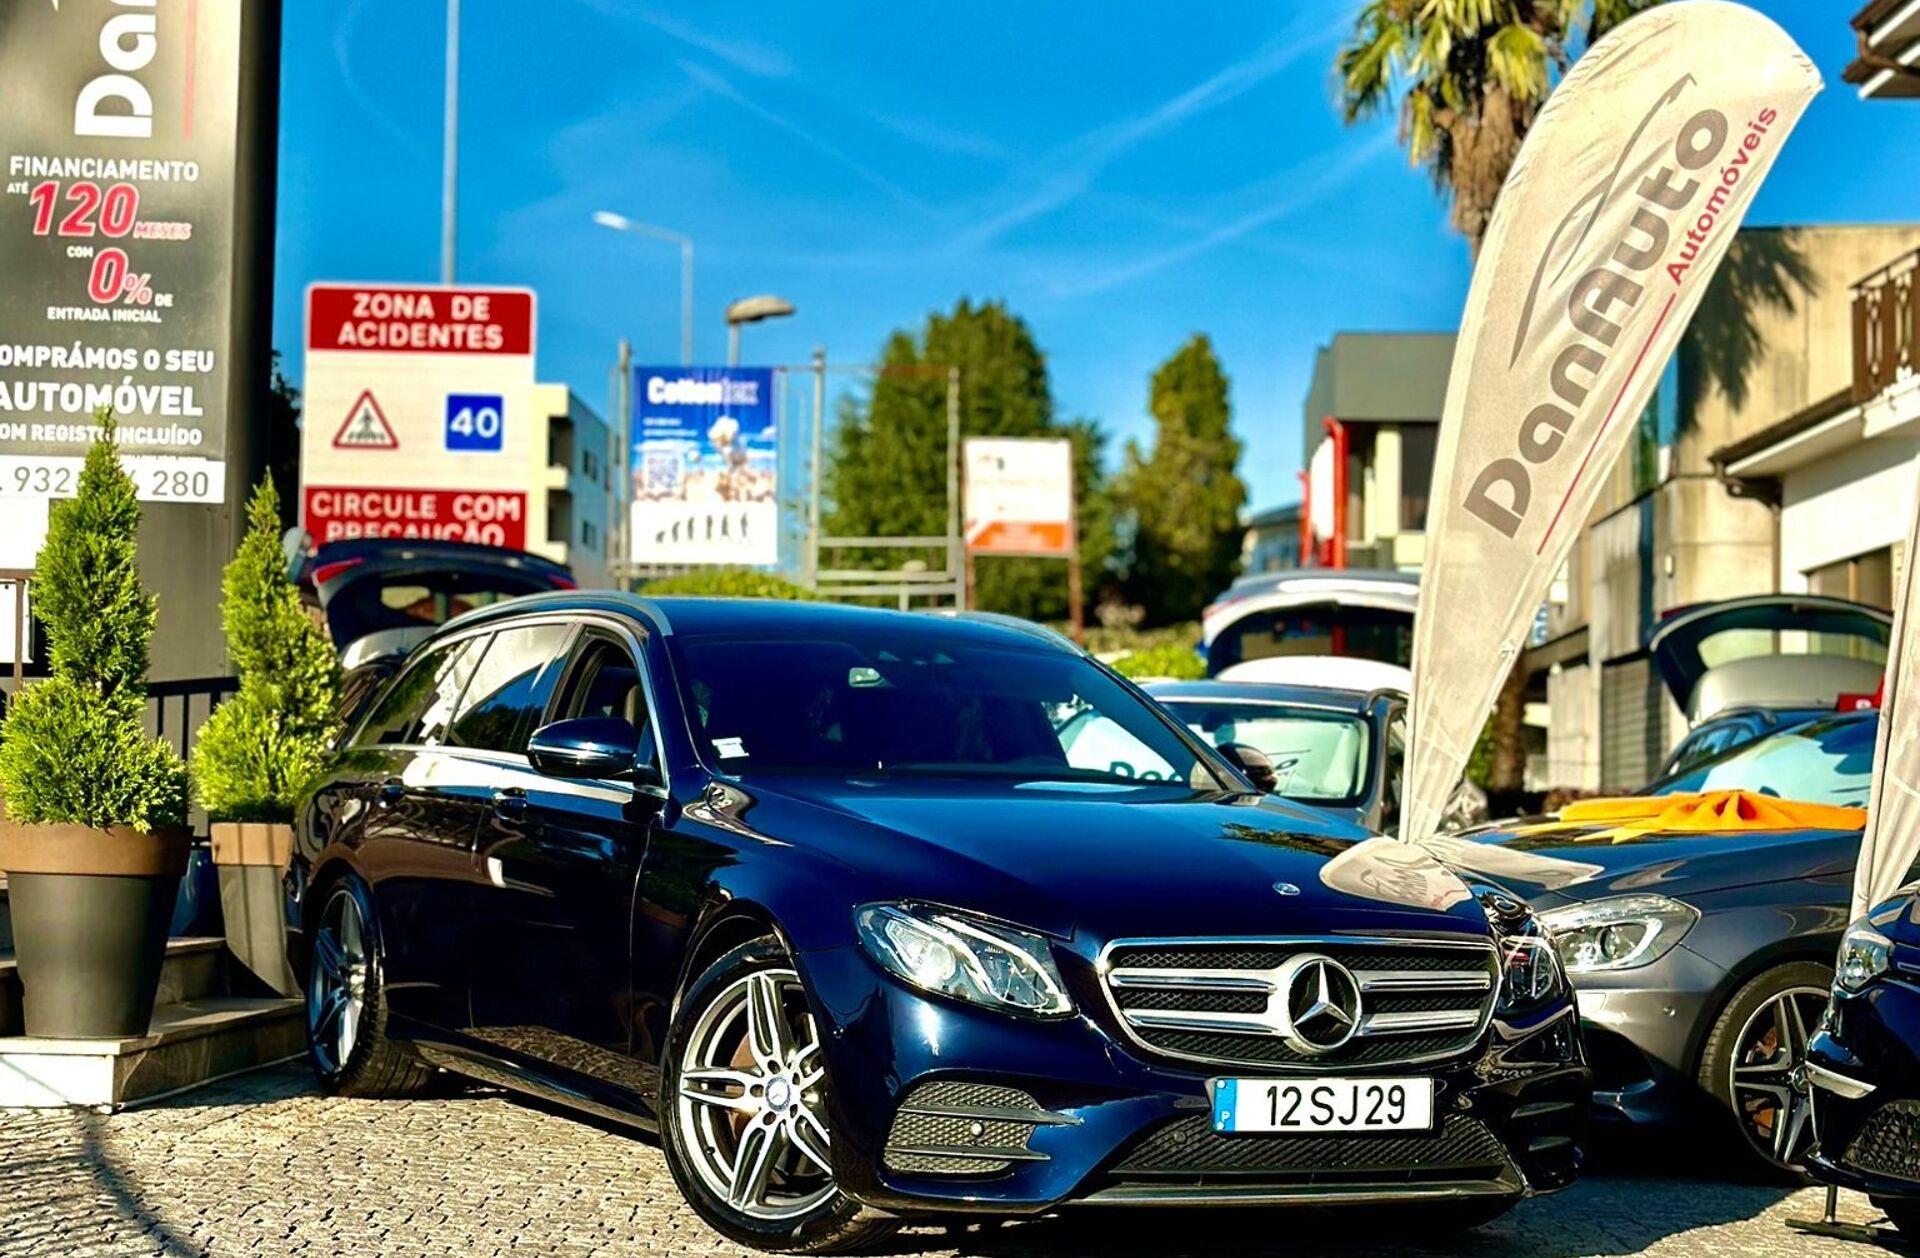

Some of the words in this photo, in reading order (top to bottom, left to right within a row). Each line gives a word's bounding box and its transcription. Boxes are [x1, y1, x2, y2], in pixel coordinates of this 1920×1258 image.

[74, 0, 157, 138] Da
[10, 156, 199, 181] FINANCIAMENTO
[7, 182, 29, 194] ATÉ
[29, 181, 139, 238] 120
[133, 221, 192, 240] MESES
[1667, 106, 1778, 286] Automóveis
[66, 246, 93, 258] COM
[88, 247, 152, 305] 0%
[155, 294, 174, 307] DE
[47, 307, 110, 322] ENTRADA
[113, 309, 162, 323] INICIAL
[352, 293, 435, 319] ZONA
[451, 295, 491, 321] DE
[337, 321, 504, 350] ACIDENTES
[1463, 108, 1730, 540] DanAuto
[143, 352, 160, 371] O
[165, 350, 214, 372] SEU
[0, 375, 203, 416] AUTOMÓVEL
[114, 422, 203, 445] INCLUÍDO
[450, 407, 500, 439] 40
[14, 466, 71, 493] 932
[152, 470, 209, 497] 280
[311, 491, 437, 519] CIRCULE
[452, 495, 521, 521] COM
